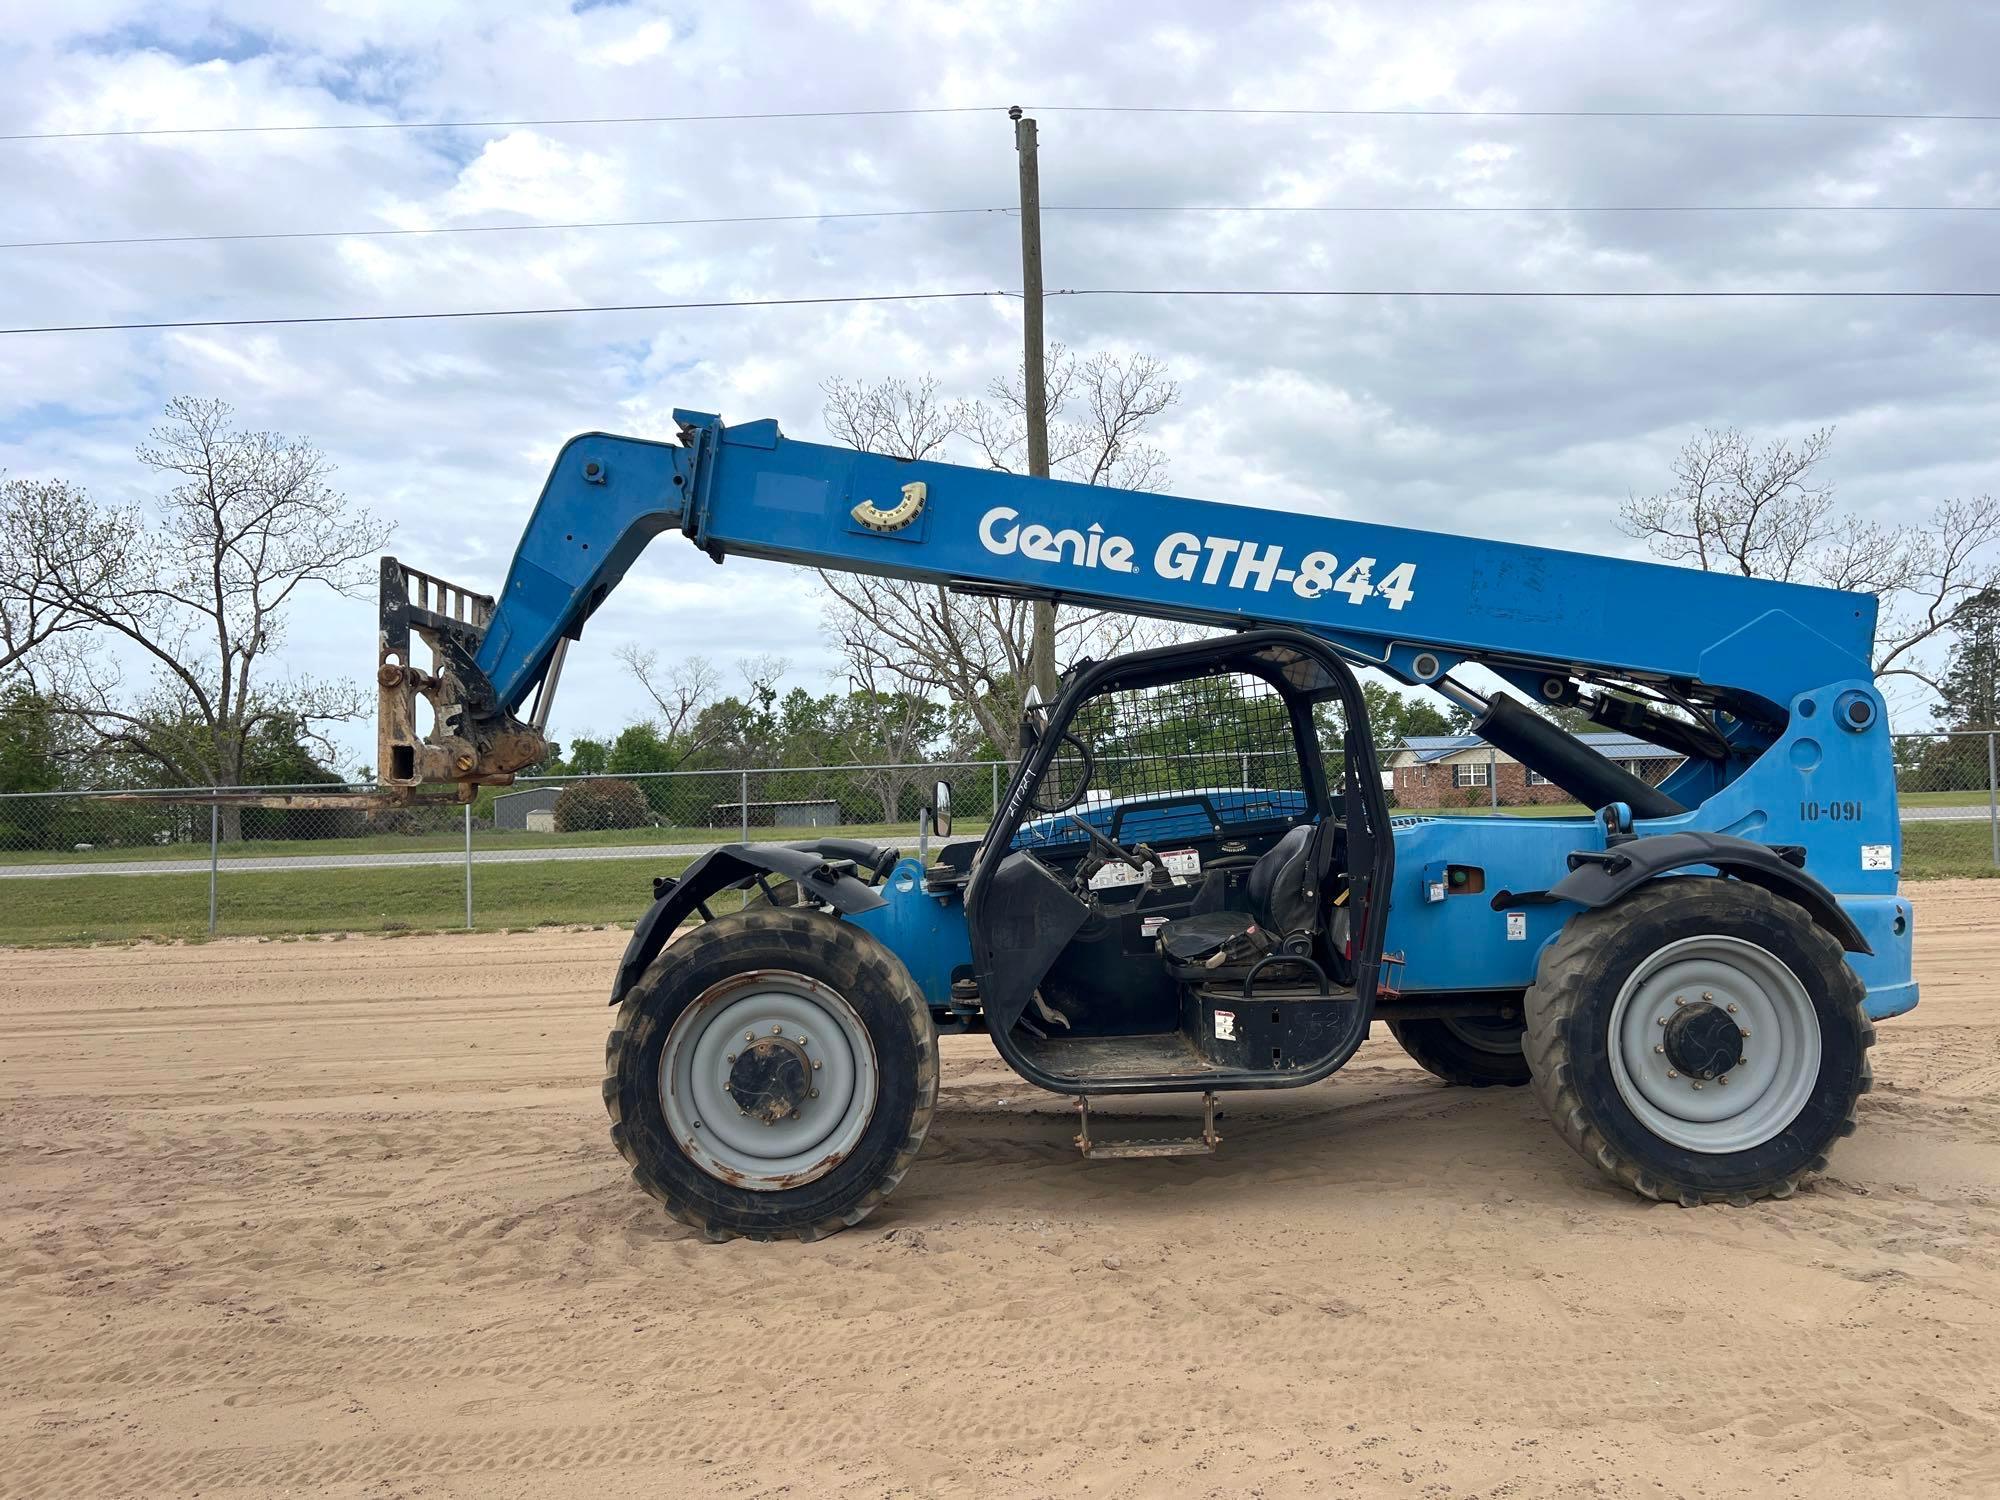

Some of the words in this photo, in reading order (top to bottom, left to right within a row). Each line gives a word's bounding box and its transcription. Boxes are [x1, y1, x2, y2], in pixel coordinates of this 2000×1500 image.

[979, 506, 1135, 573] Genie
[1153, 531, 1418, 611] GTH-844
[1800, 801, 1862, 821] 10-091
